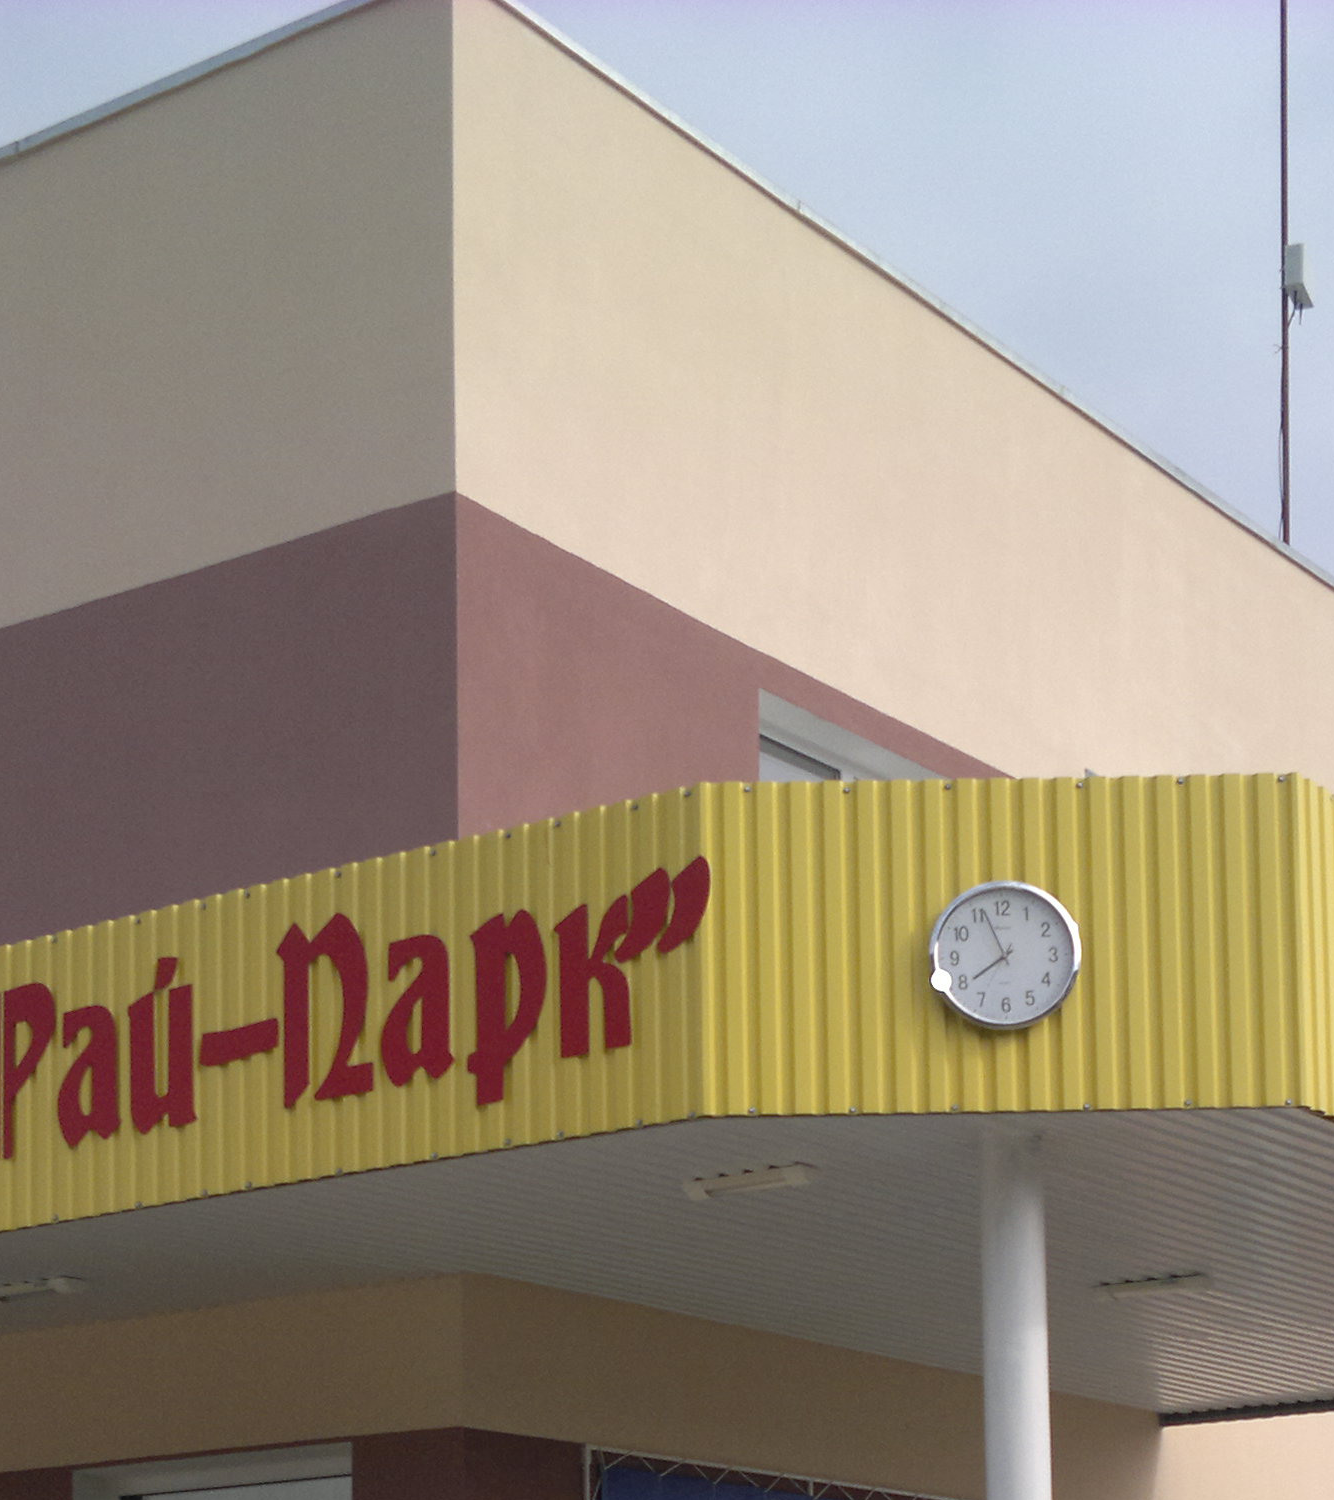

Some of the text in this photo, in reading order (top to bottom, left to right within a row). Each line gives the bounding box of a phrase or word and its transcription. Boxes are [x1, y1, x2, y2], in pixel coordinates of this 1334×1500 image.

[972, 908, 985, 923] 11
[995, 900, 1011, 917] 12
[953, 925, 970, 943] 10
[1041, 921, 1052, 938] 2
[949, 950, 960, 967] 9
[1048, 946, 1059, 963] 3
[957, 974, 969, 991] 8
[1041, 971, 1051, 987] 4
[976, 991, 986, 1008] 7
[1001, 996, 1012, 1014] 6
[1025, 990, 1036, 1007] 5
